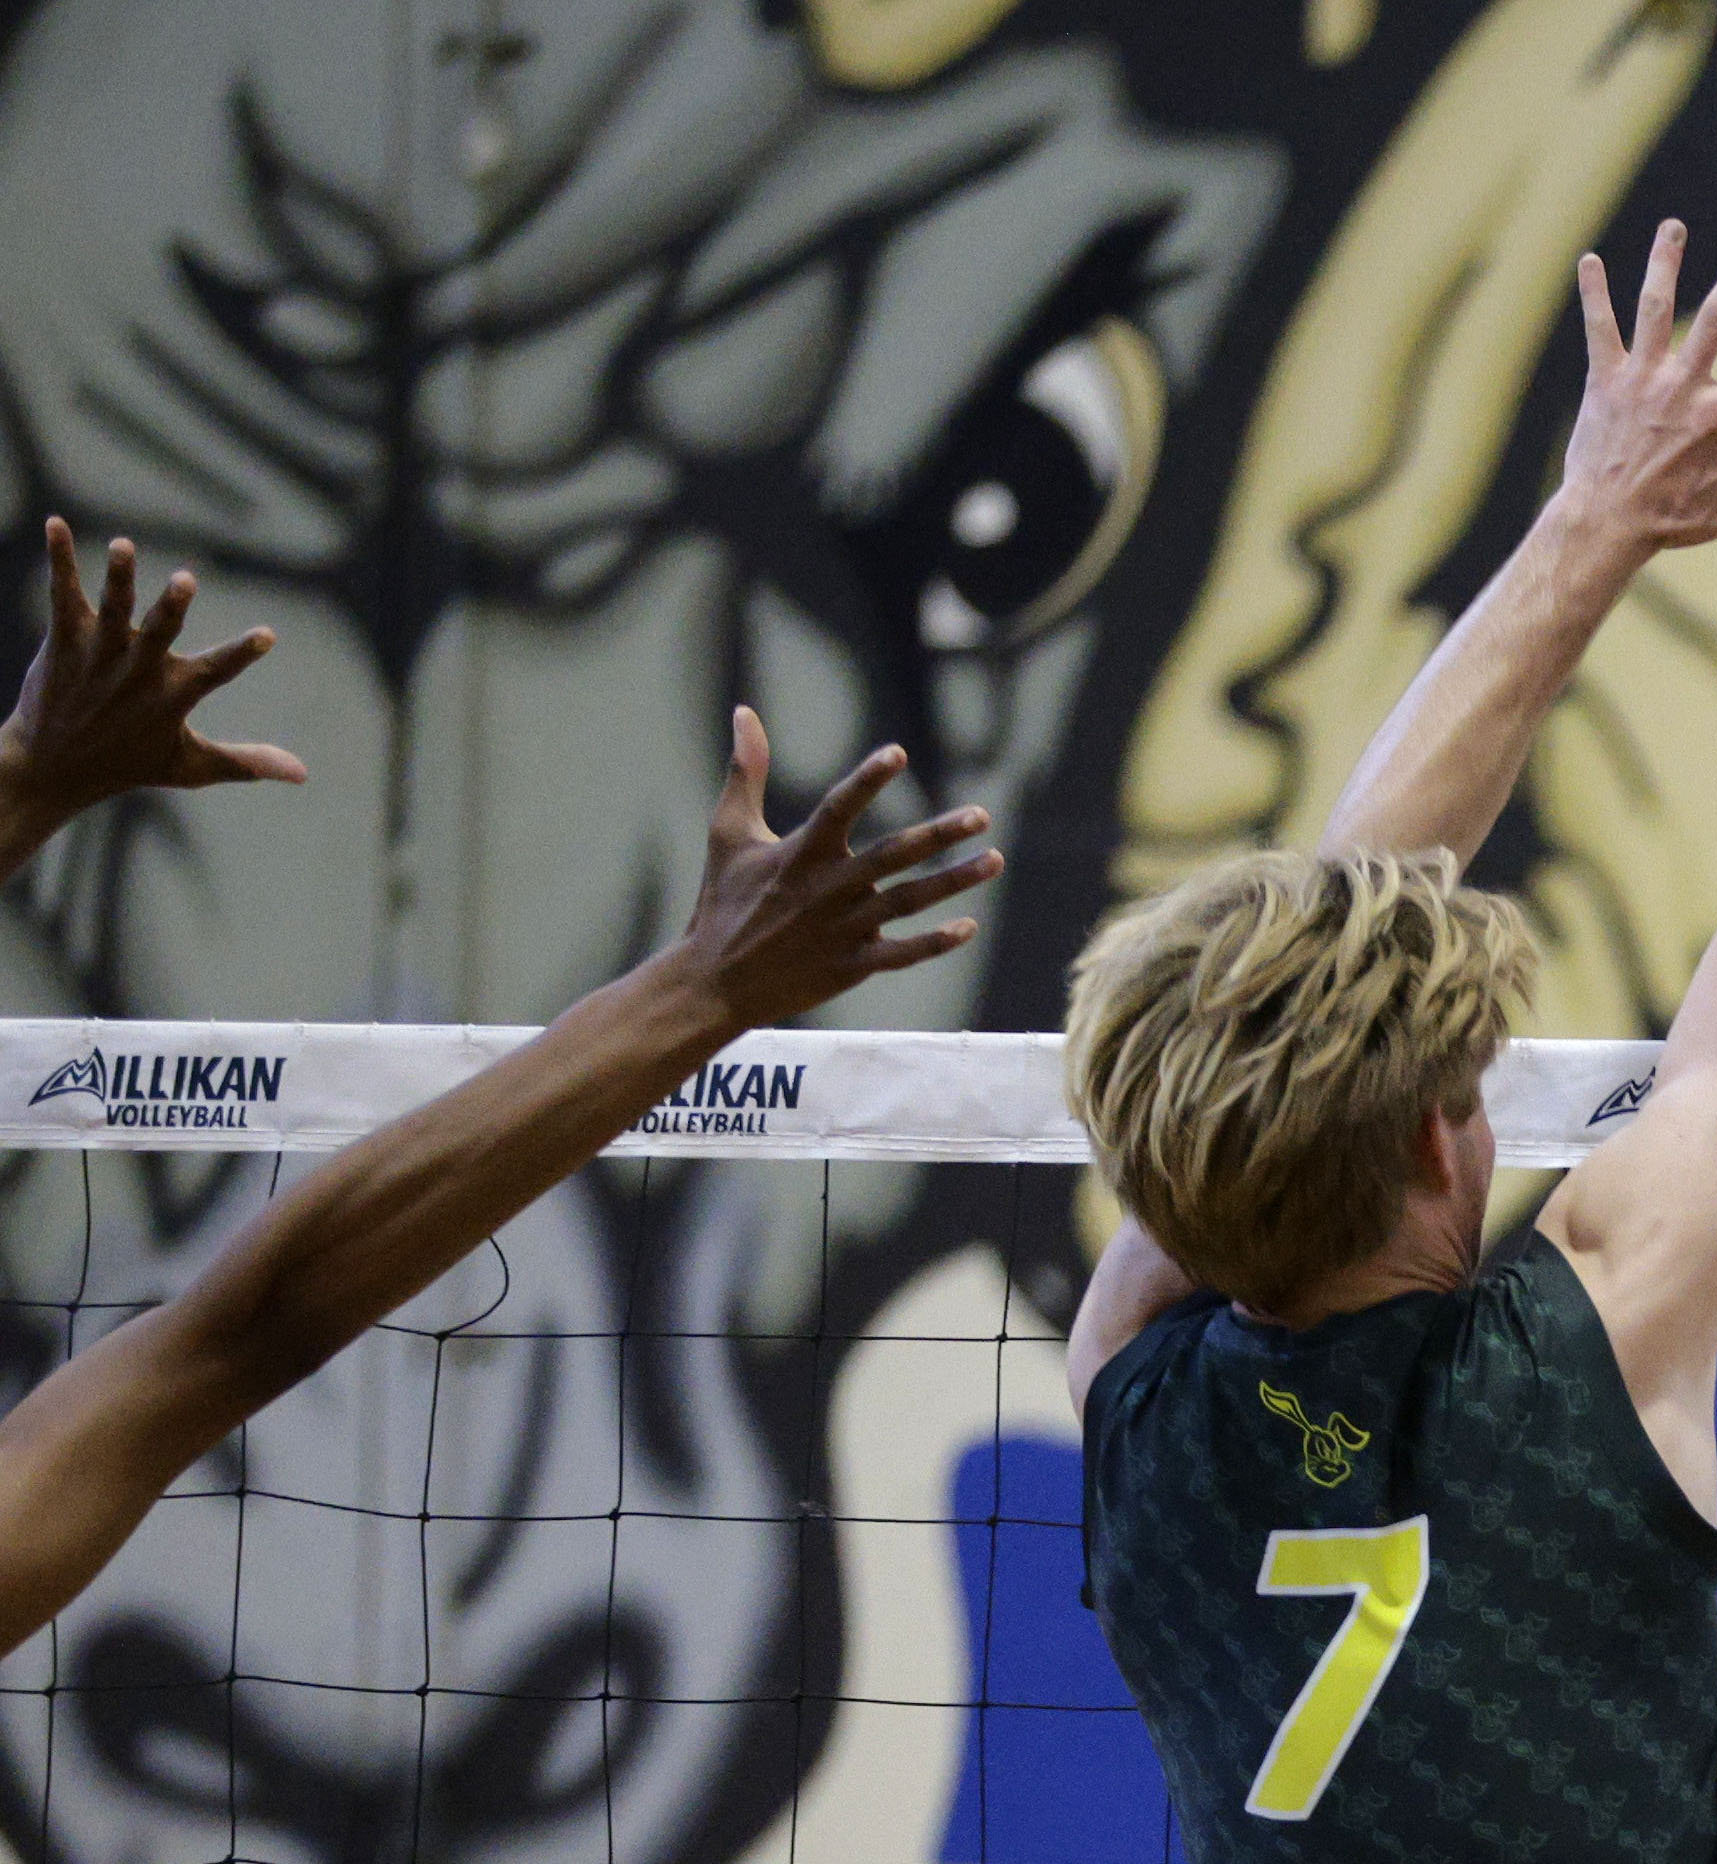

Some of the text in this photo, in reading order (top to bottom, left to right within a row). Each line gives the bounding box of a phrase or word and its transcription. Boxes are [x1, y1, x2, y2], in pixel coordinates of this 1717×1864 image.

[28, 1046, 287, 1106] MILLIKAN
[655, 1062, 807, 1109] LIKAN
[106, 1104, 248, 1128] VOLLEYBALL
[1245, 1513, 1430, 1821] 7
